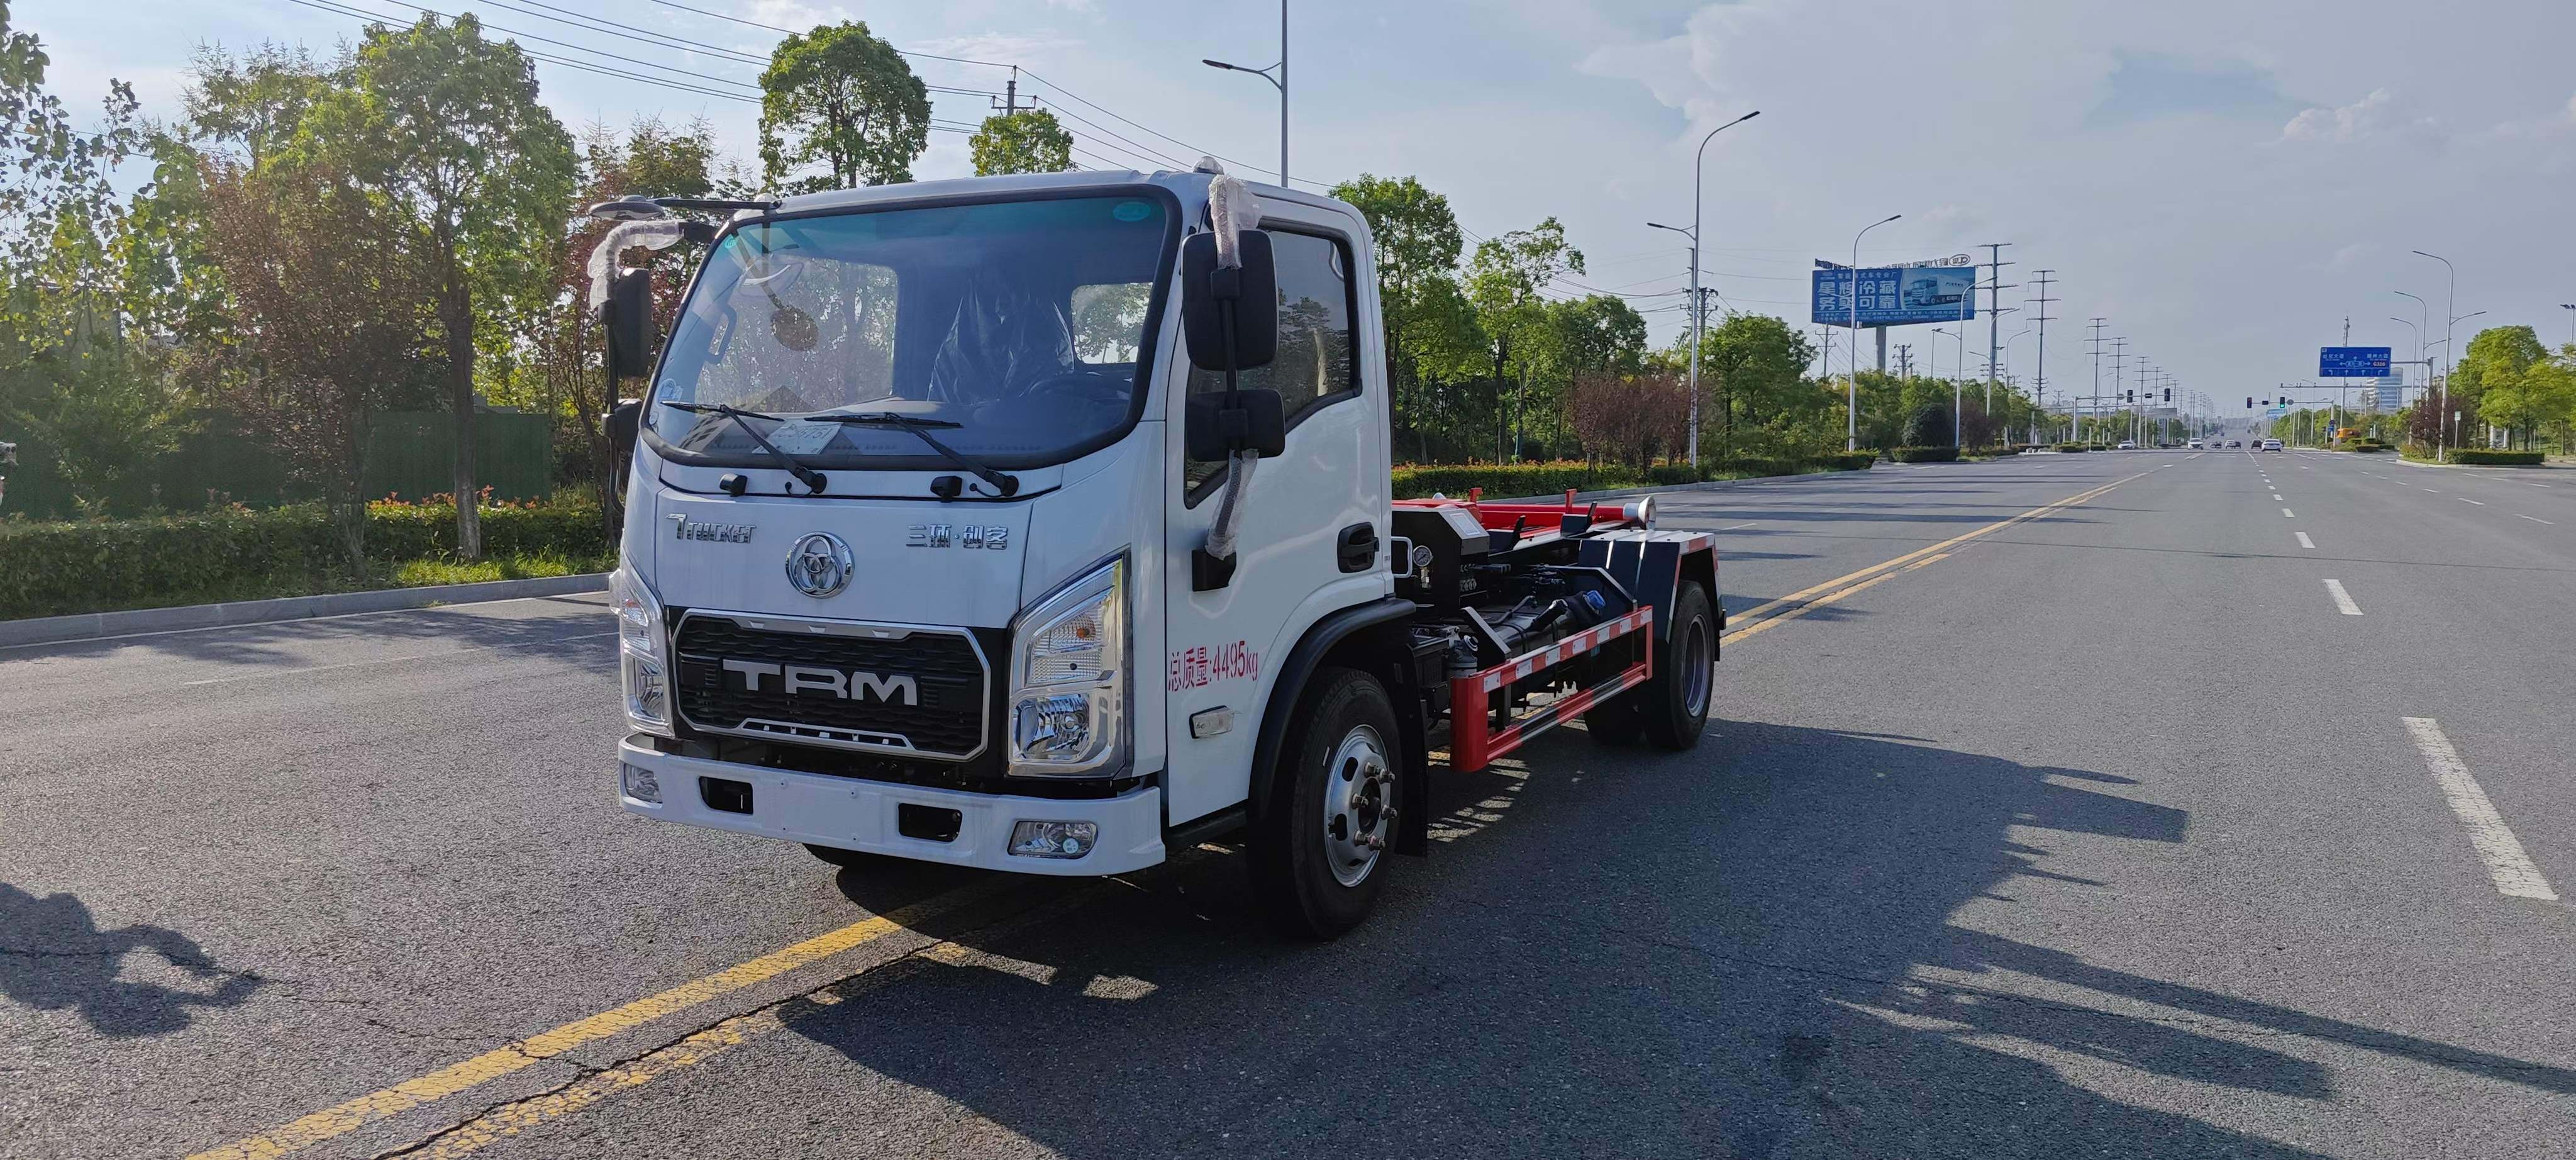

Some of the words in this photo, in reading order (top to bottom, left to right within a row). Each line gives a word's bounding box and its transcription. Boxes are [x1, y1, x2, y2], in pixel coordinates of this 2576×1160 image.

[723, 659, 918, 706] TRM
[1169, 640, 1258, 692] 总质量:4495kg
